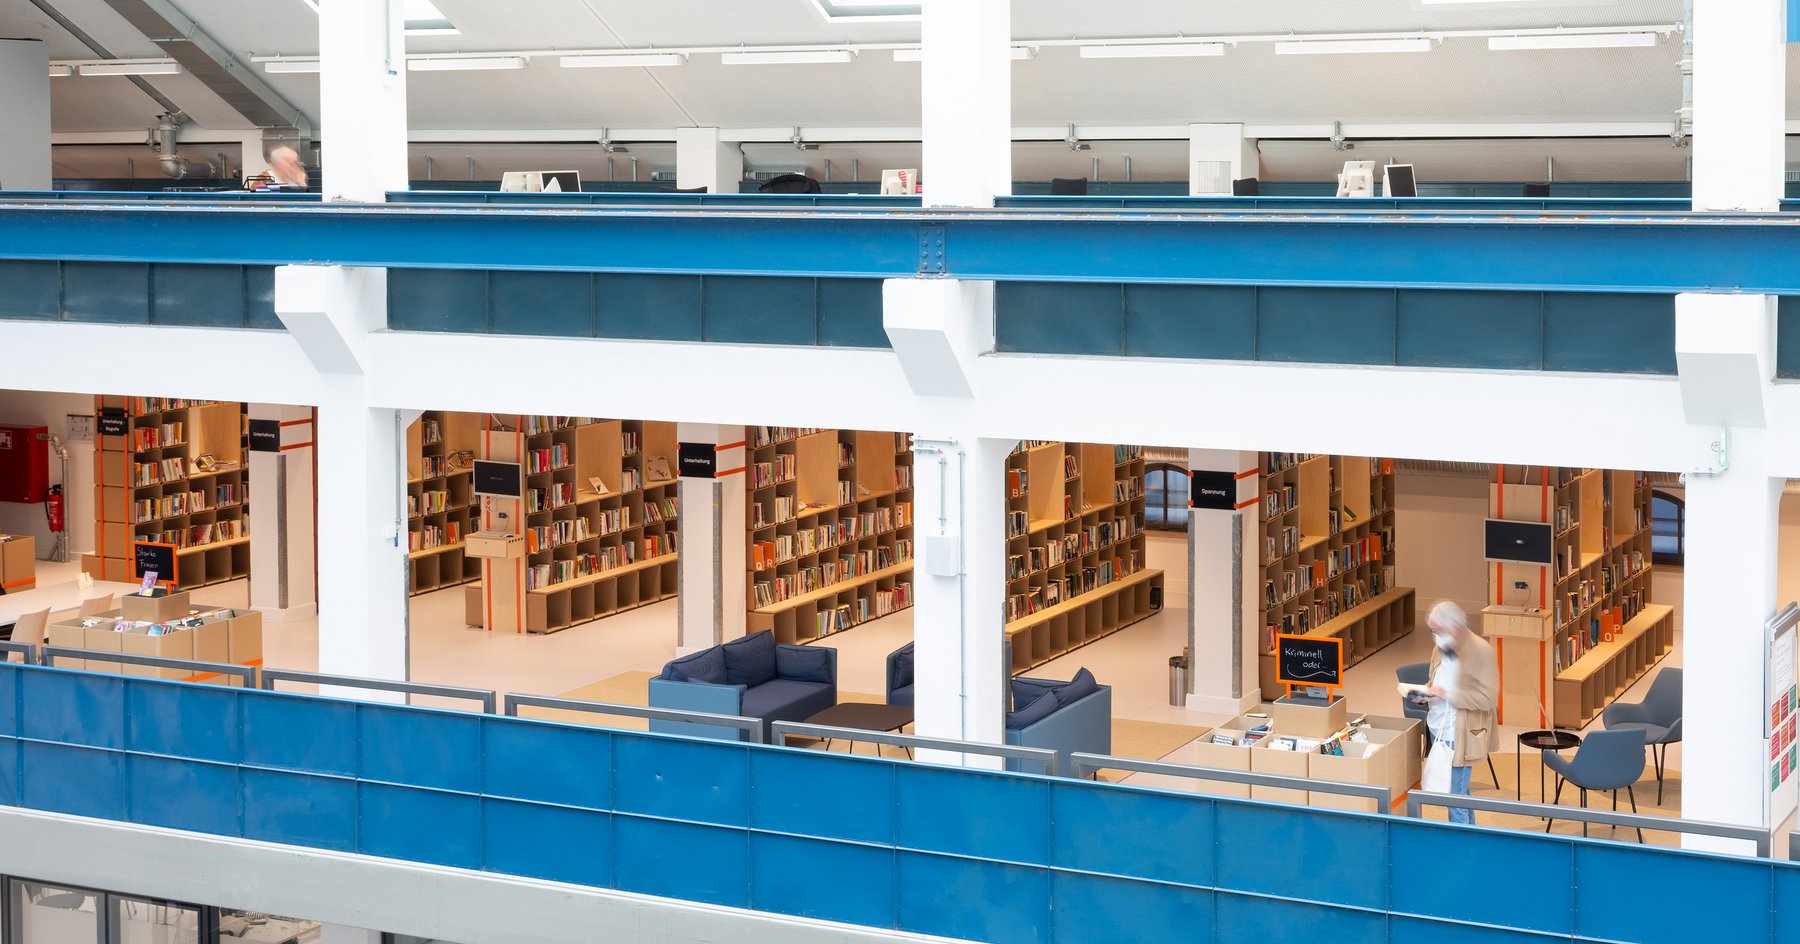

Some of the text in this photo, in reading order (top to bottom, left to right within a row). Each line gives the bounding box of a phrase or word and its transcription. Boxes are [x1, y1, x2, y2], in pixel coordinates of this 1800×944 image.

[137, 444, 143, 452] A
[684, 457, 710, 465] Unterhaltung
[1385, 467, 1391, 475] J
[1012, 488, 1019, 497] B
[1201, 488, 1226, 497] Spannung
[450, 536, 456, 544] H
[136, 545, 157, 558] Starke
[139, 558, 159, 569] Frauen
[755, 561, 763, 571] Q
[767, 559, 773, 568] R
[1316, 578, 1323, 586] H
[1613, 624, 1621, 633] P
[1604, 632, 1612, 642] O
[1284, 647, 1324, 662] Kriminell
